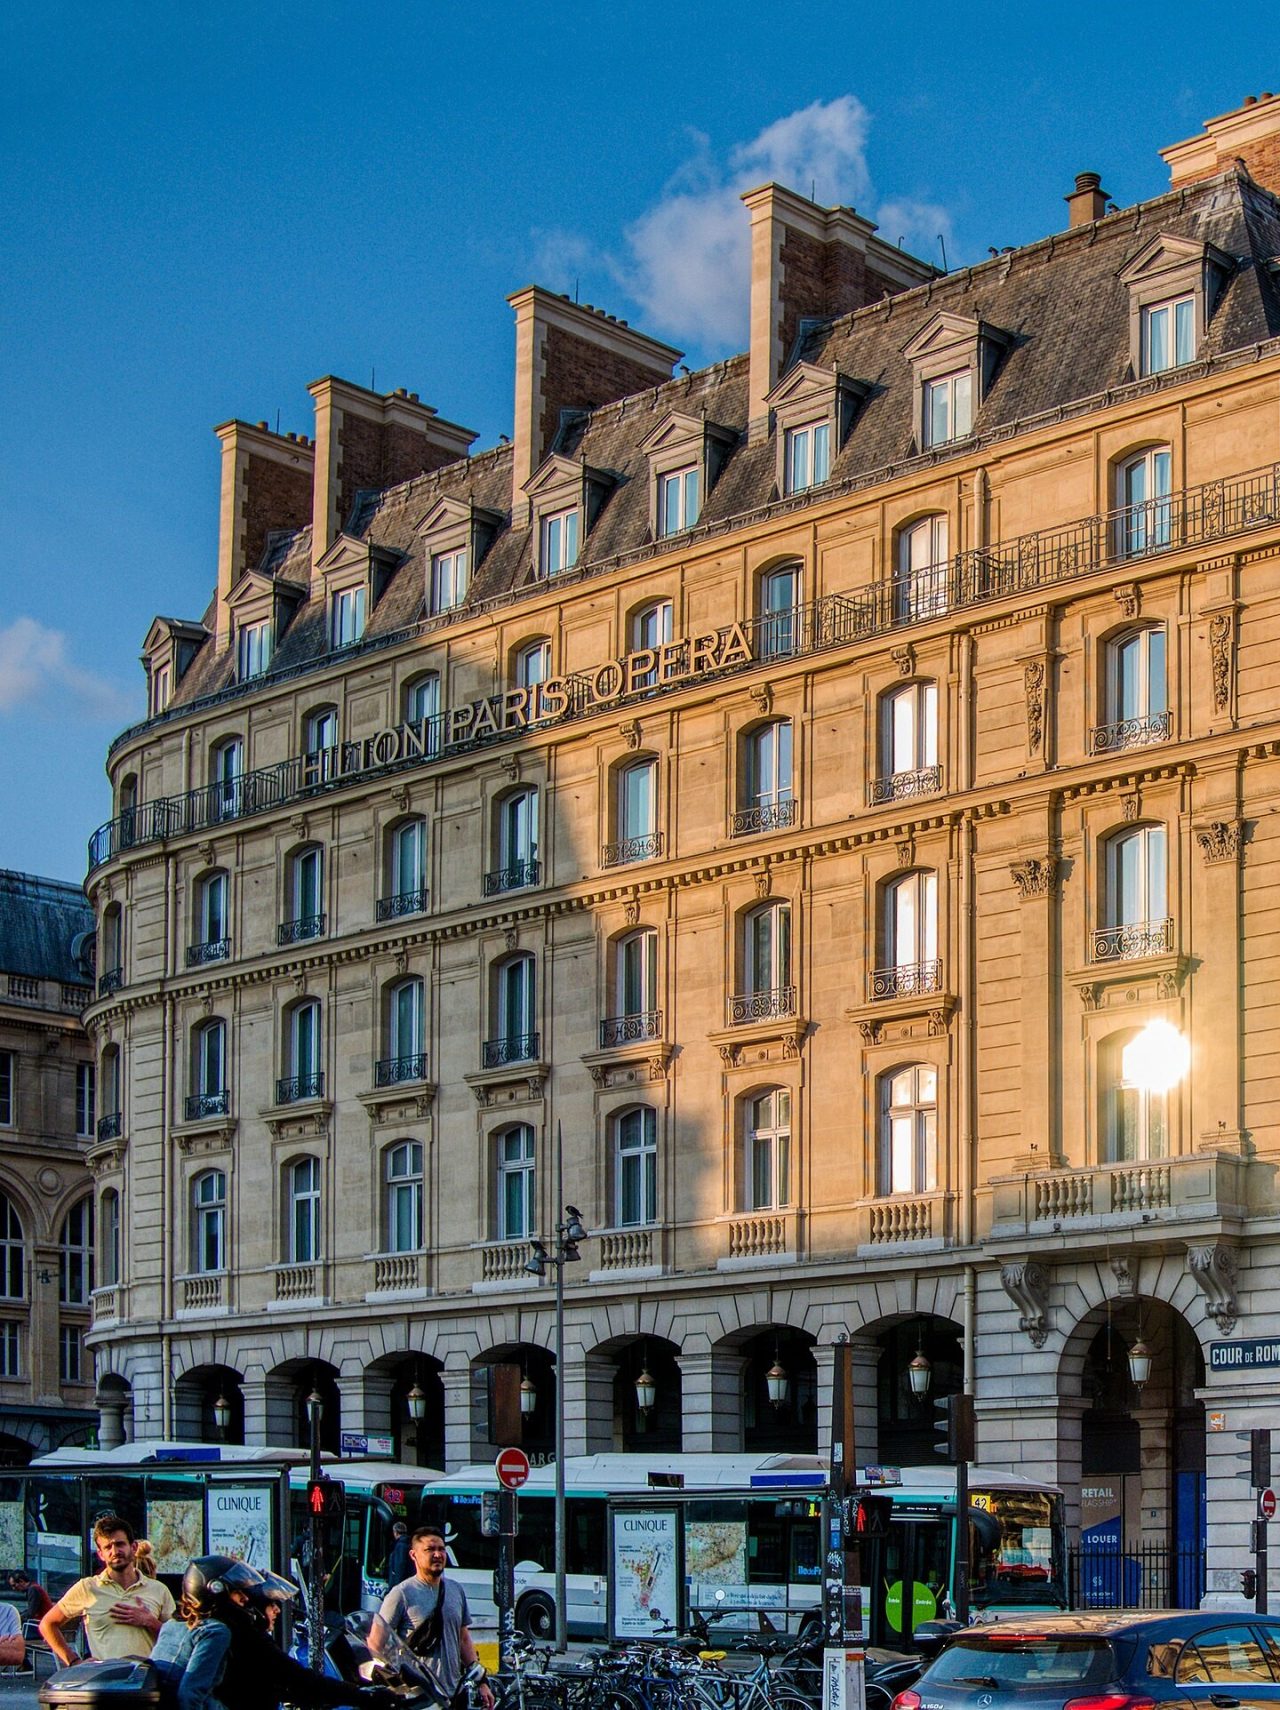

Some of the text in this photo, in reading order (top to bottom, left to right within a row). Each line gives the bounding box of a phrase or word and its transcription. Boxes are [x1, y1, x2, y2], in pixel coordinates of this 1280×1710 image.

[301, 622, 753, 789] HILTON PARIS OPERA
[1212, 1347, 1243, 1365] COUR
[1244, 1352, 1254, 1363] DE
[526, 1452, 556, 1466] ARG
[388, 1489, 402, 1504] 42
[1081, 1488, 1114, 1498] RETAIL
[217, 1496, 261, 1513] CLINIQUE
[974, 1497, 987, 1510] 42
[623, 1519, 668, 1533] CLINIQUE
[1087, 1535, 1118, 1544] LOUER
